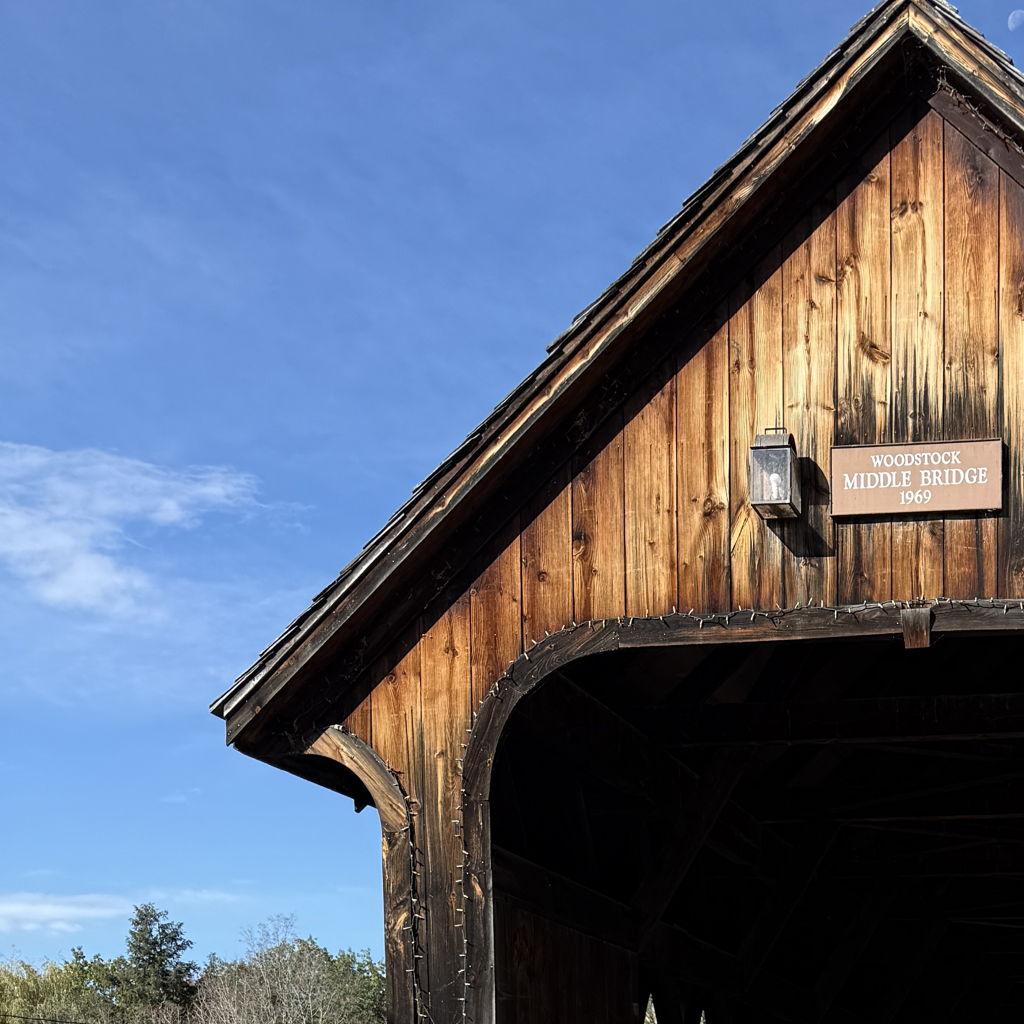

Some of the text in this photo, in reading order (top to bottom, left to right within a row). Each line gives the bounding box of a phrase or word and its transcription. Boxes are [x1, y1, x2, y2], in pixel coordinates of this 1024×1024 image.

[870, 451, 961, 467] WOODSTOCK
[843, 467, 988, 490] MIDDLE BRIDGE
[899, 490, 931, 504] 1969
